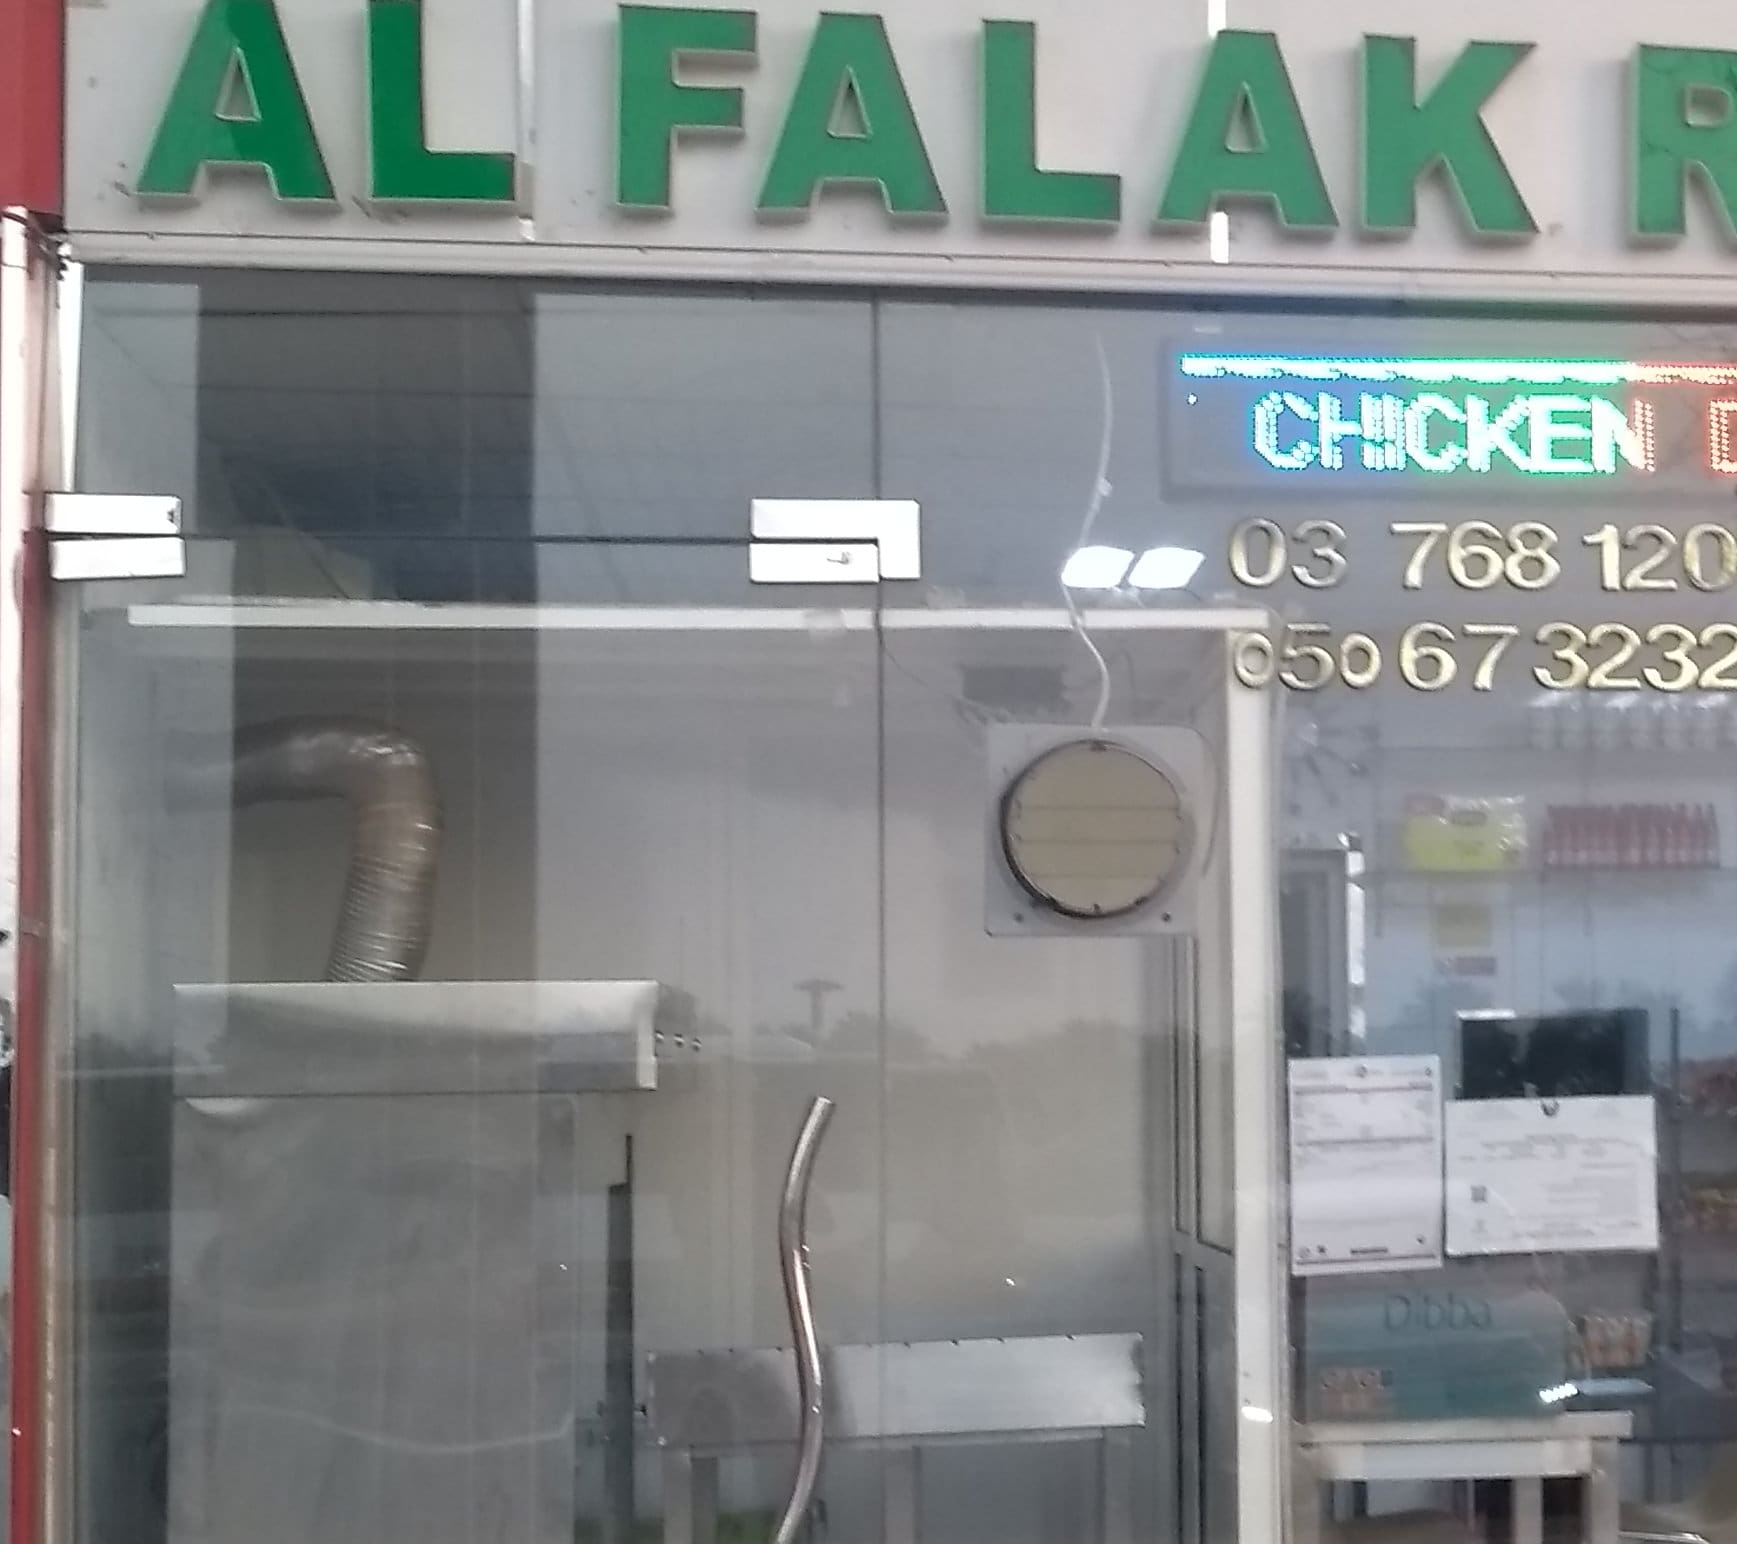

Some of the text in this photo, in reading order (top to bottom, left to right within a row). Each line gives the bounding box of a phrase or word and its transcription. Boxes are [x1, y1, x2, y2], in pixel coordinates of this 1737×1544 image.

[613, 3, 1543, 242] FALAK
[1253, 391, 1655, 475] CHICKEN
[1228, 516, 1348, 589] 03
[1390, 520, 1561, 590] 768
[1384, 1289, 1493, 1331] Dibba
